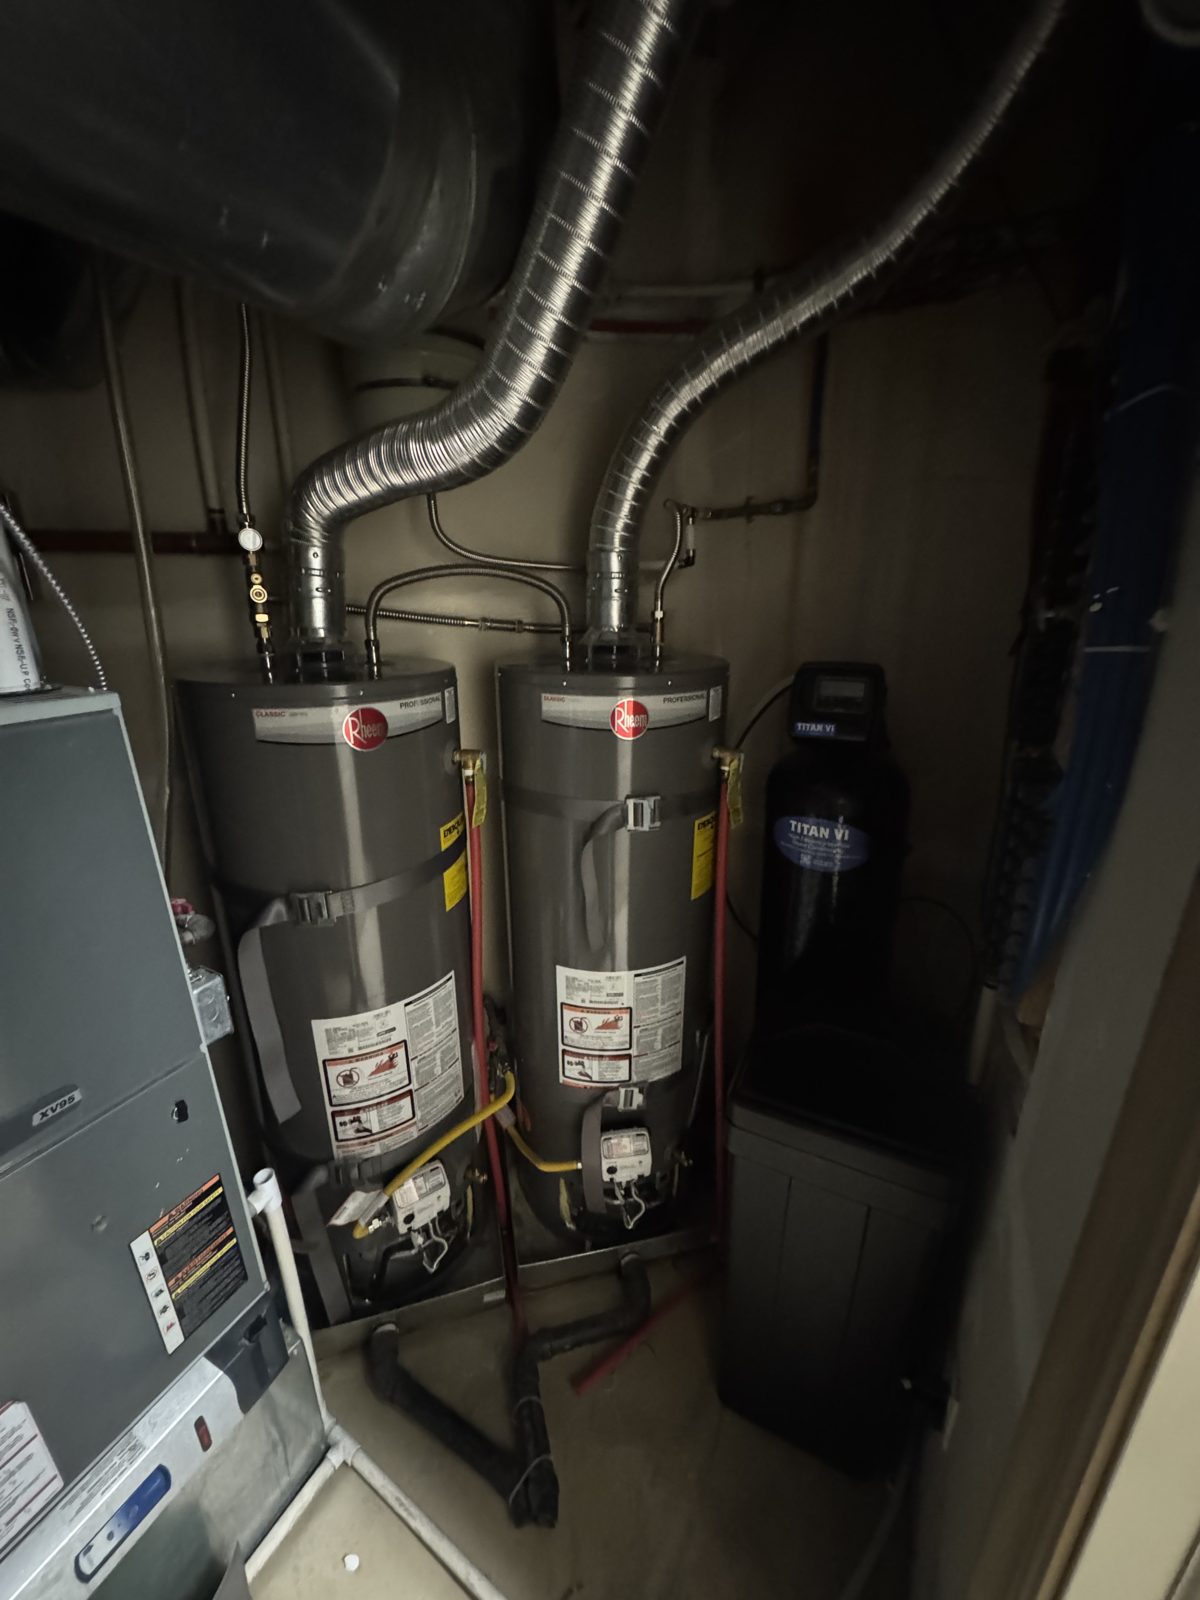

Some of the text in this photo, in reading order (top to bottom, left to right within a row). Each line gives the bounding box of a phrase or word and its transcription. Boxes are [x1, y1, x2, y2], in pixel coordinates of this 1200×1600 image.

[399, 695, 441, 709] PROFSSIONAL
[348, 708, 385, 744] Rheem
[614, 699, 648, 733] Rheem
[796, 722, 836, 732] TITAN VI
[788, 819, 850, 841] TITAN VI
[39, 1095, 76, 1121] XV95
